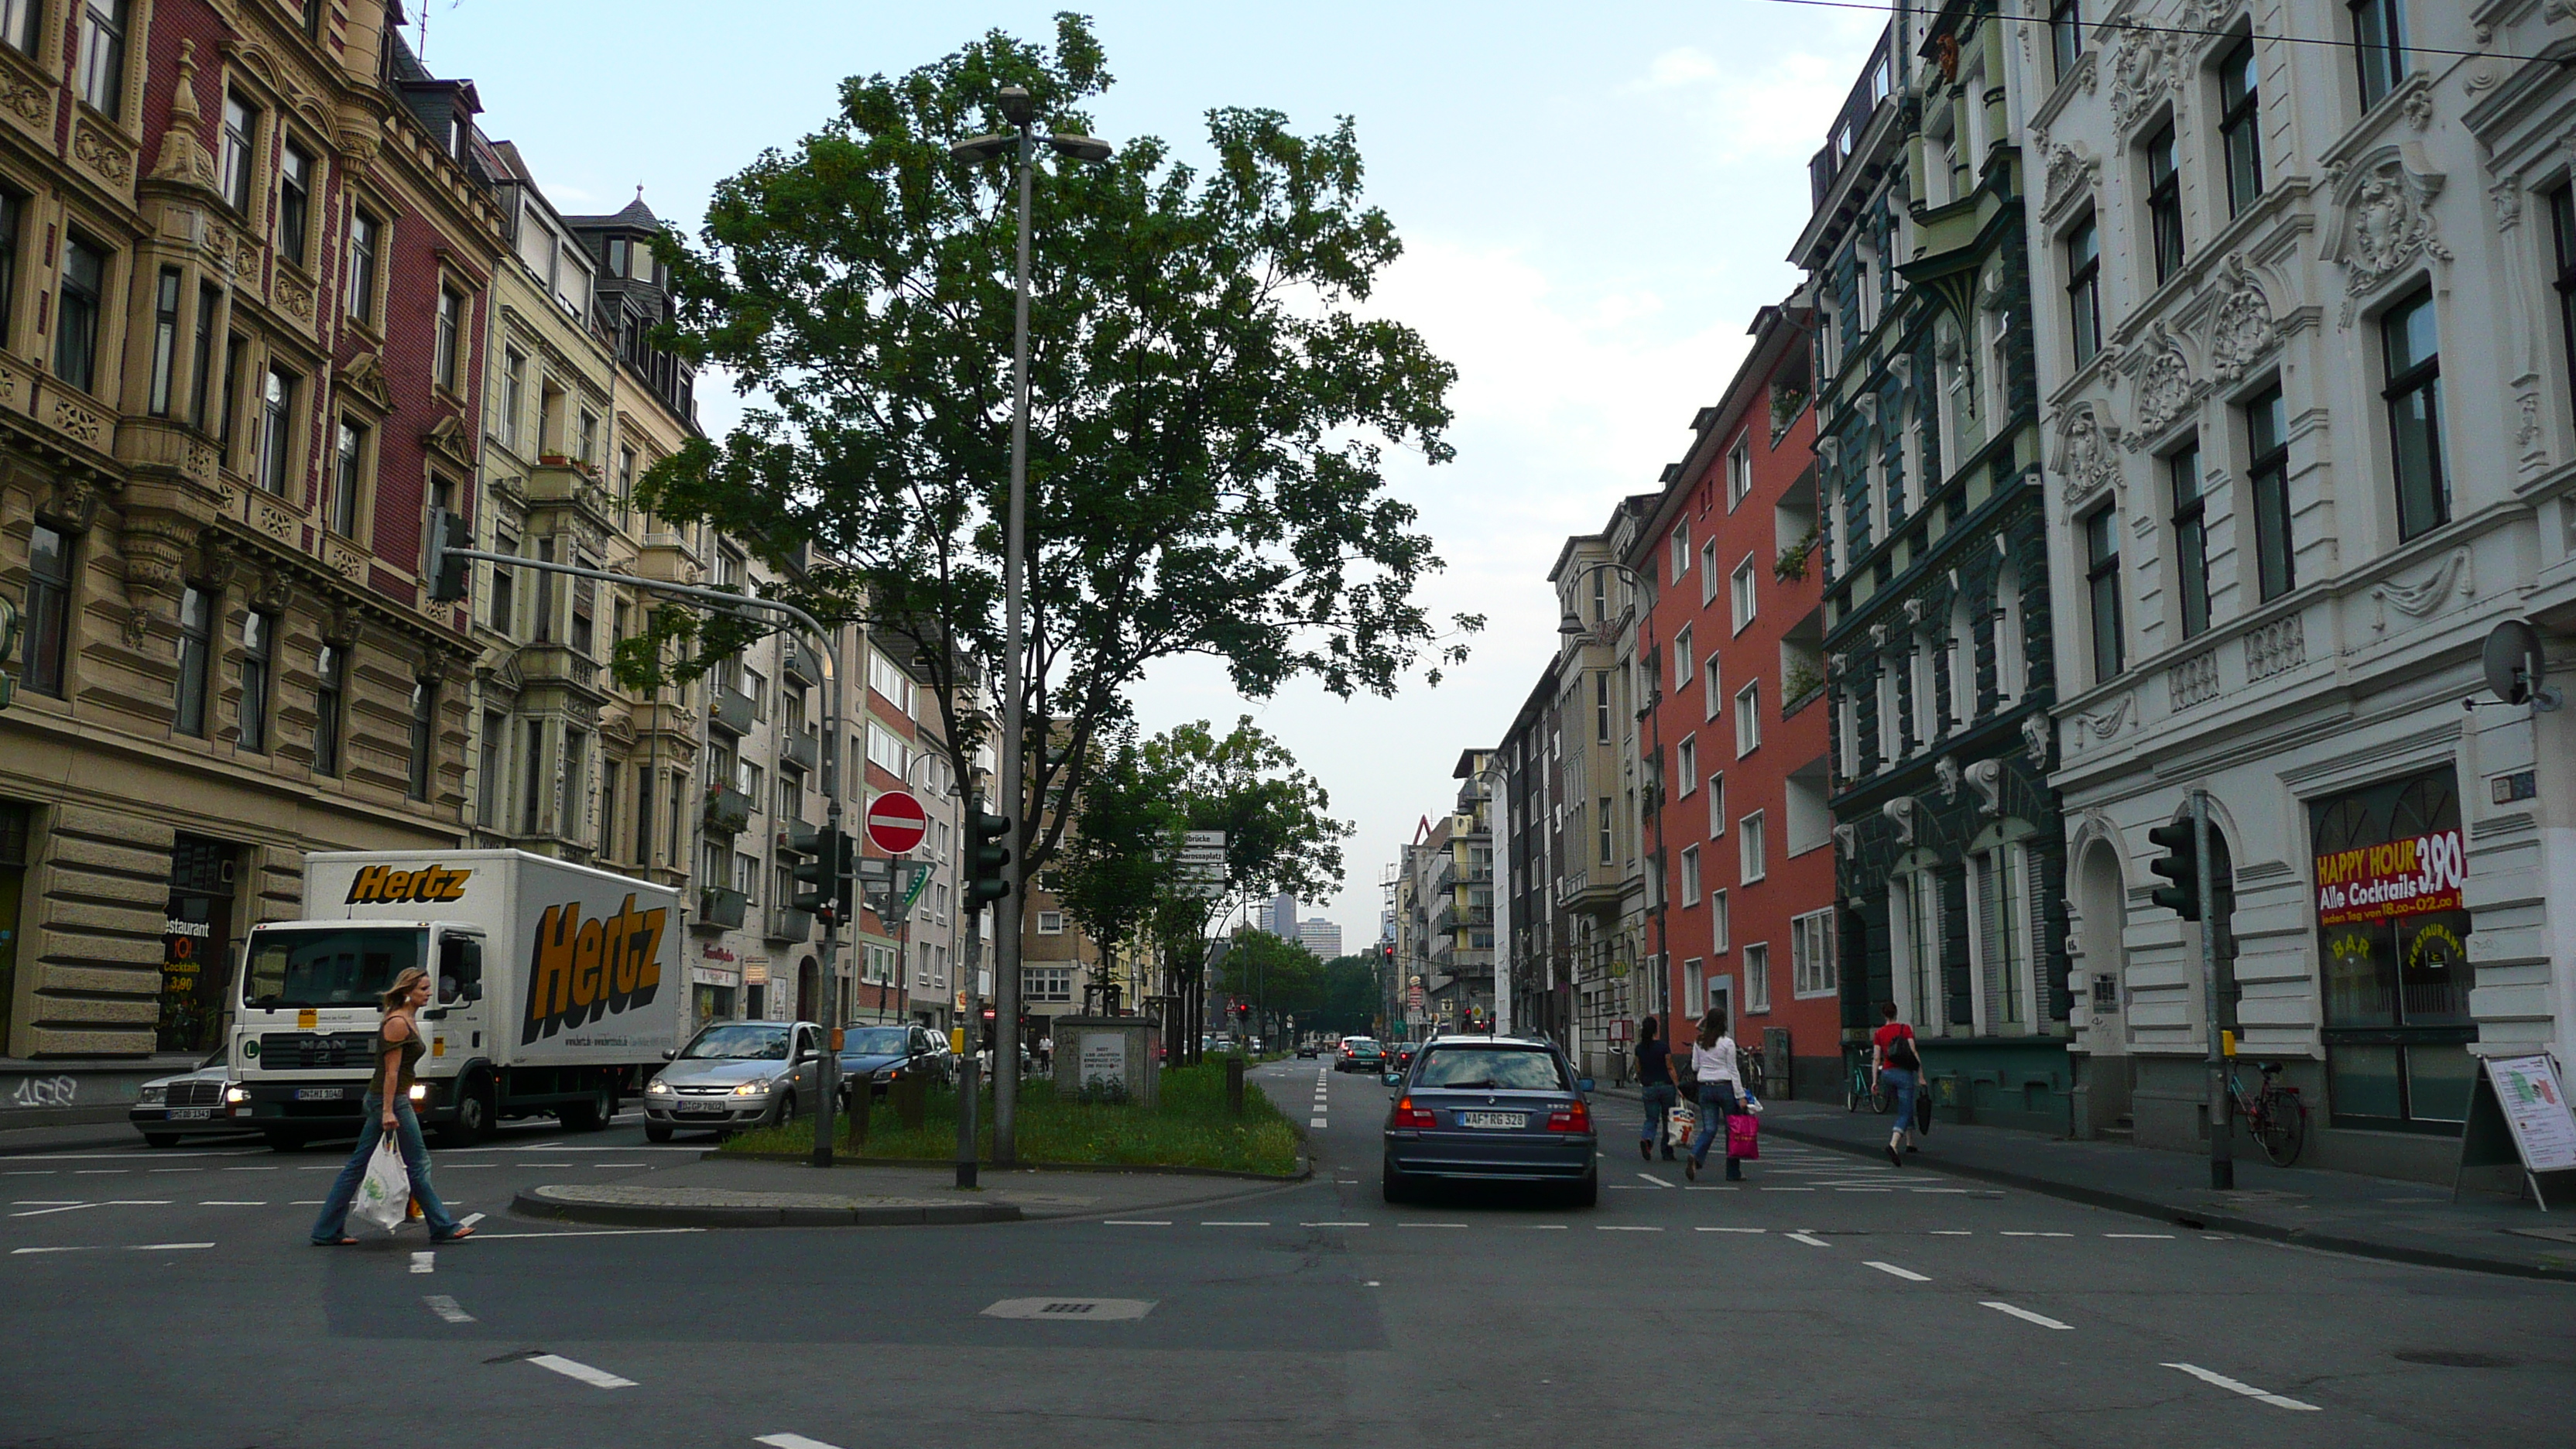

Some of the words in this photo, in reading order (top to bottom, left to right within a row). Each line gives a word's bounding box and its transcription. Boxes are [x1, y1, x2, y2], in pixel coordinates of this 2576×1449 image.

[1180, 852, 1222, 861] barossaplatz
[2317, 849, 2365, 885] HAPPY
[2369, 840, 2417, 877] HOUR
[344, 864, 472, 905] Hertz
[2320, 886, 2345, 910] Alle
[2349, 874, 2417, 906] Cocktails
[2322, 913, 2345, 926] jeden
[2345, 910, 2362, 922] Tag
[2332, 933, 2370, 959] BAR
[2408, 923, 2465, 968] RESTAURANT
[163, 961, 200, 973] Cocktails
[521, 892, 667, 1046] Hertz
[300, 1040, 347, 1050] MAN
[1465, 1113, 1484, 1125] WAF
[1490, 1114, 1503, 1125] RG
